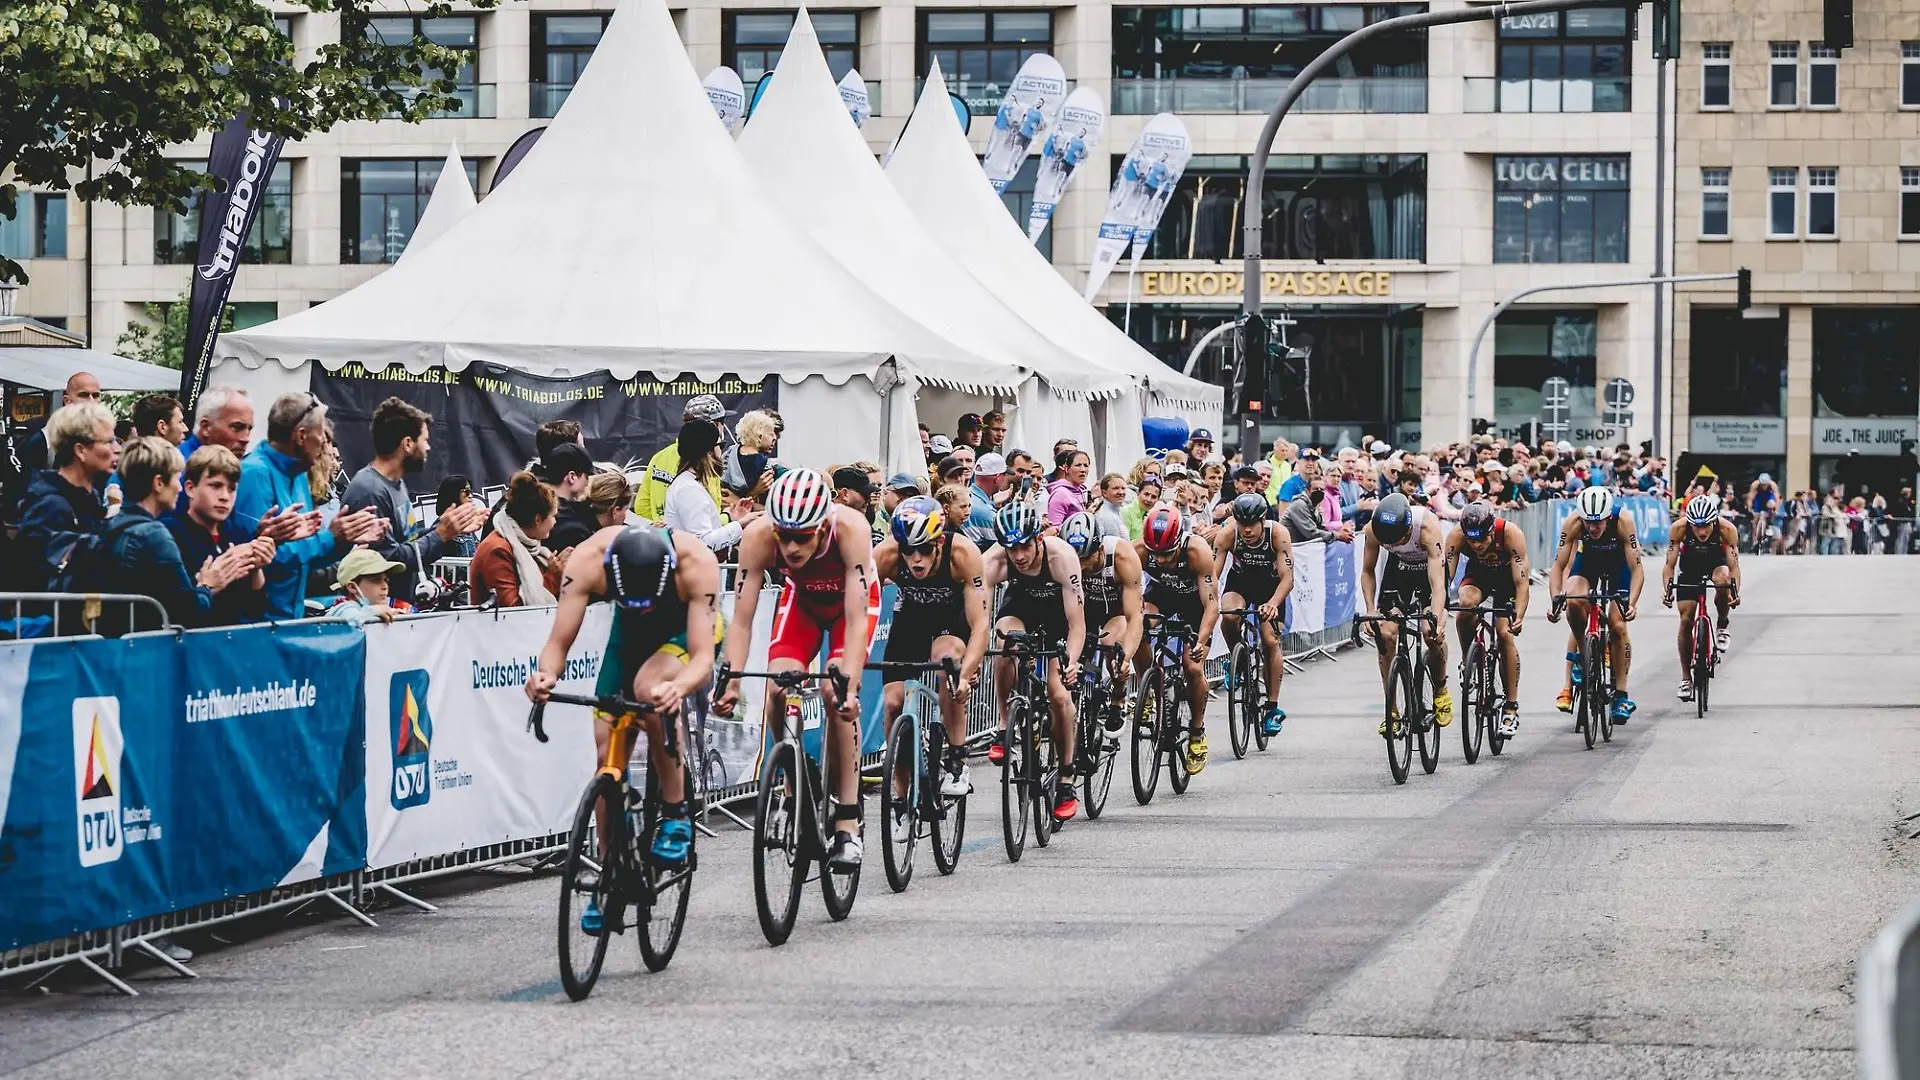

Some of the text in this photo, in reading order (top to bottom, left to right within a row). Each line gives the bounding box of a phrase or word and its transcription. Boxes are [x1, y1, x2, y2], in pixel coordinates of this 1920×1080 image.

[1501, 14, 1555, 29] PLAY21
[1022, 80, 1058, 90] ACTIVE
[1497, 162, 1626, 181] LUCA CELLI
[1263, 272, 1391, 296] PASSAGE
[474, 376, 604, 405] WWW.TRIABOLOS.DE
[1576, 428, 1615, 440] SHOP
[1822, 428, 1842, 443] JOE
[1851, 428, 1872, 443] THE
[1874, 428, 1907, 444] JUICE
[1629, 534, 1637, 549] 20
[562, 575, 573, 588] 7
[973, 576, 983, 588] 5
[1069, 574, 1079, 585] 2
[1204, 574, 1212, 583] 3
[704, 593, 716, 606] 7
[1625, 642, 1631, 659] 20
[472, 657, 526, 689] Deutsche
[395, 761, 426, 800] DTU
[83, 809, 116, 852] DTU
